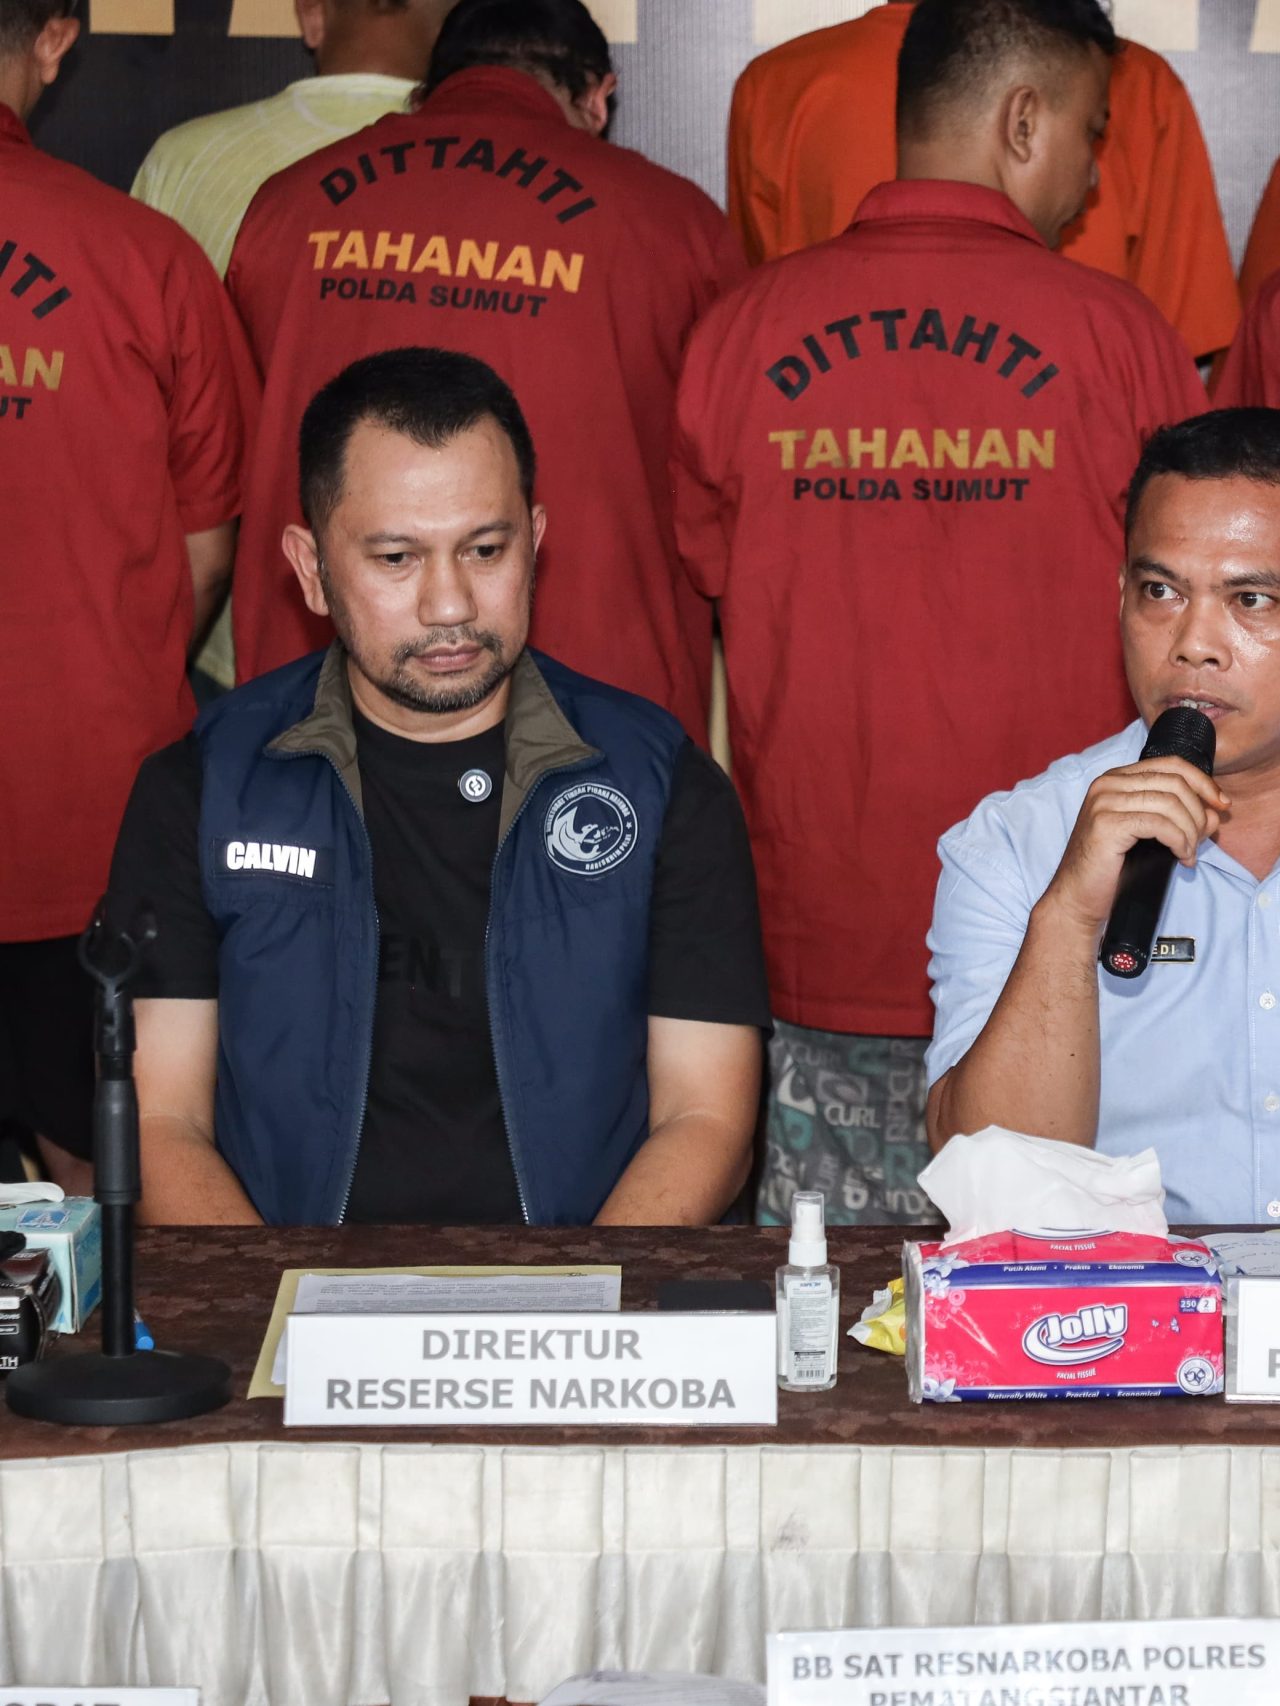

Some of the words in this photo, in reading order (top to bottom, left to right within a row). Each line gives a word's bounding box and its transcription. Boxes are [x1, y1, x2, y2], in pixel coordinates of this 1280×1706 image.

[319, 136, 597, 225] DITTAHTI
[308, 230, 584, 293] TAHANAN
[320, 277, 417, 304] POLDA
[429, 284, 547, 317] SUMUT
[765, 308, 1060, 401] DITTAHTI
[768, 428, 1056, 470] TAHANAN
[793, 477, 902, 501] POLDA
[912, 478, 1031, 502] SUMUT
[226, 841, 317, 878] CALVIN
[824, 1102, 881, 1128] CURL
[1074, 1242, 1097, 1251] TISSUE
[1180, 1300, 1197, 1308] 250
[1045, 1303, 1129, 1348] Jolly
[421, 1328, 643, 1361] DIREKTUR
[325, 1377, 514, 1410] RESERSE
[529, 1376, 737, 1410] NARKOBA
[988, 1391, 1024, 1400] Naturally
[1025, 1391, 1048, 1400] White
[1065, 1390, 1100, 1399] Practical
[1117, 1389, 1162, 1398] Economical
[792, 1655, 833, 1681] BB
[843, 1653, 903, 1679] SAT
[914, 1647, 1132, 1677] RESNARKOBA
[1143, 1644, 1267, 1671] POLRES
